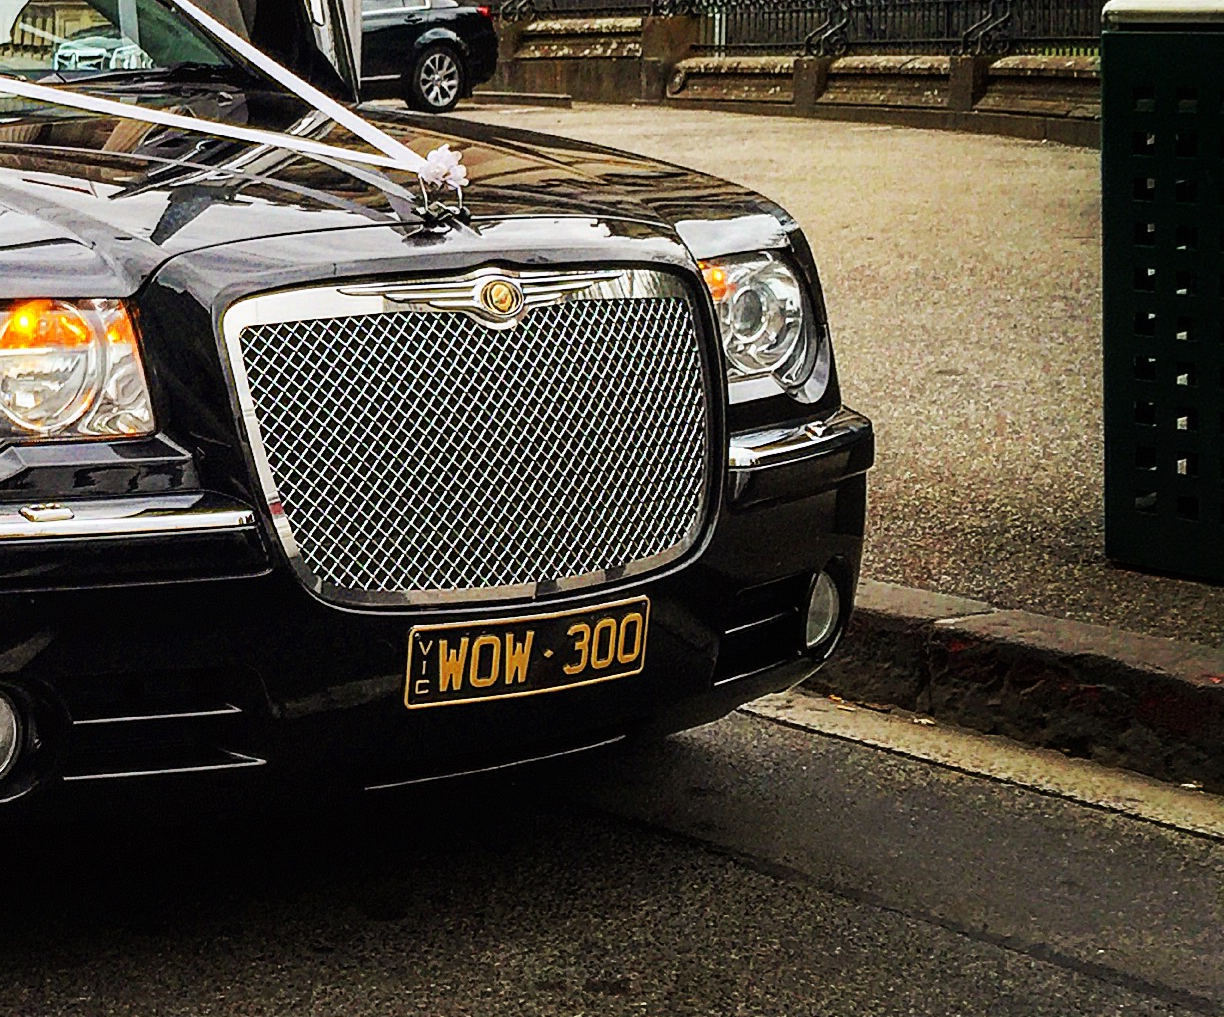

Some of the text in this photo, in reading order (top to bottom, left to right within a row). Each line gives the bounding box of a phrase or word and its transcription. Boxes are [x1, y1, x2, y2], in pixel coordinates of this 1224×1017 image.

[414, 639, 434, 695] VIC
[438, 612, 643, 693] WOW 300
